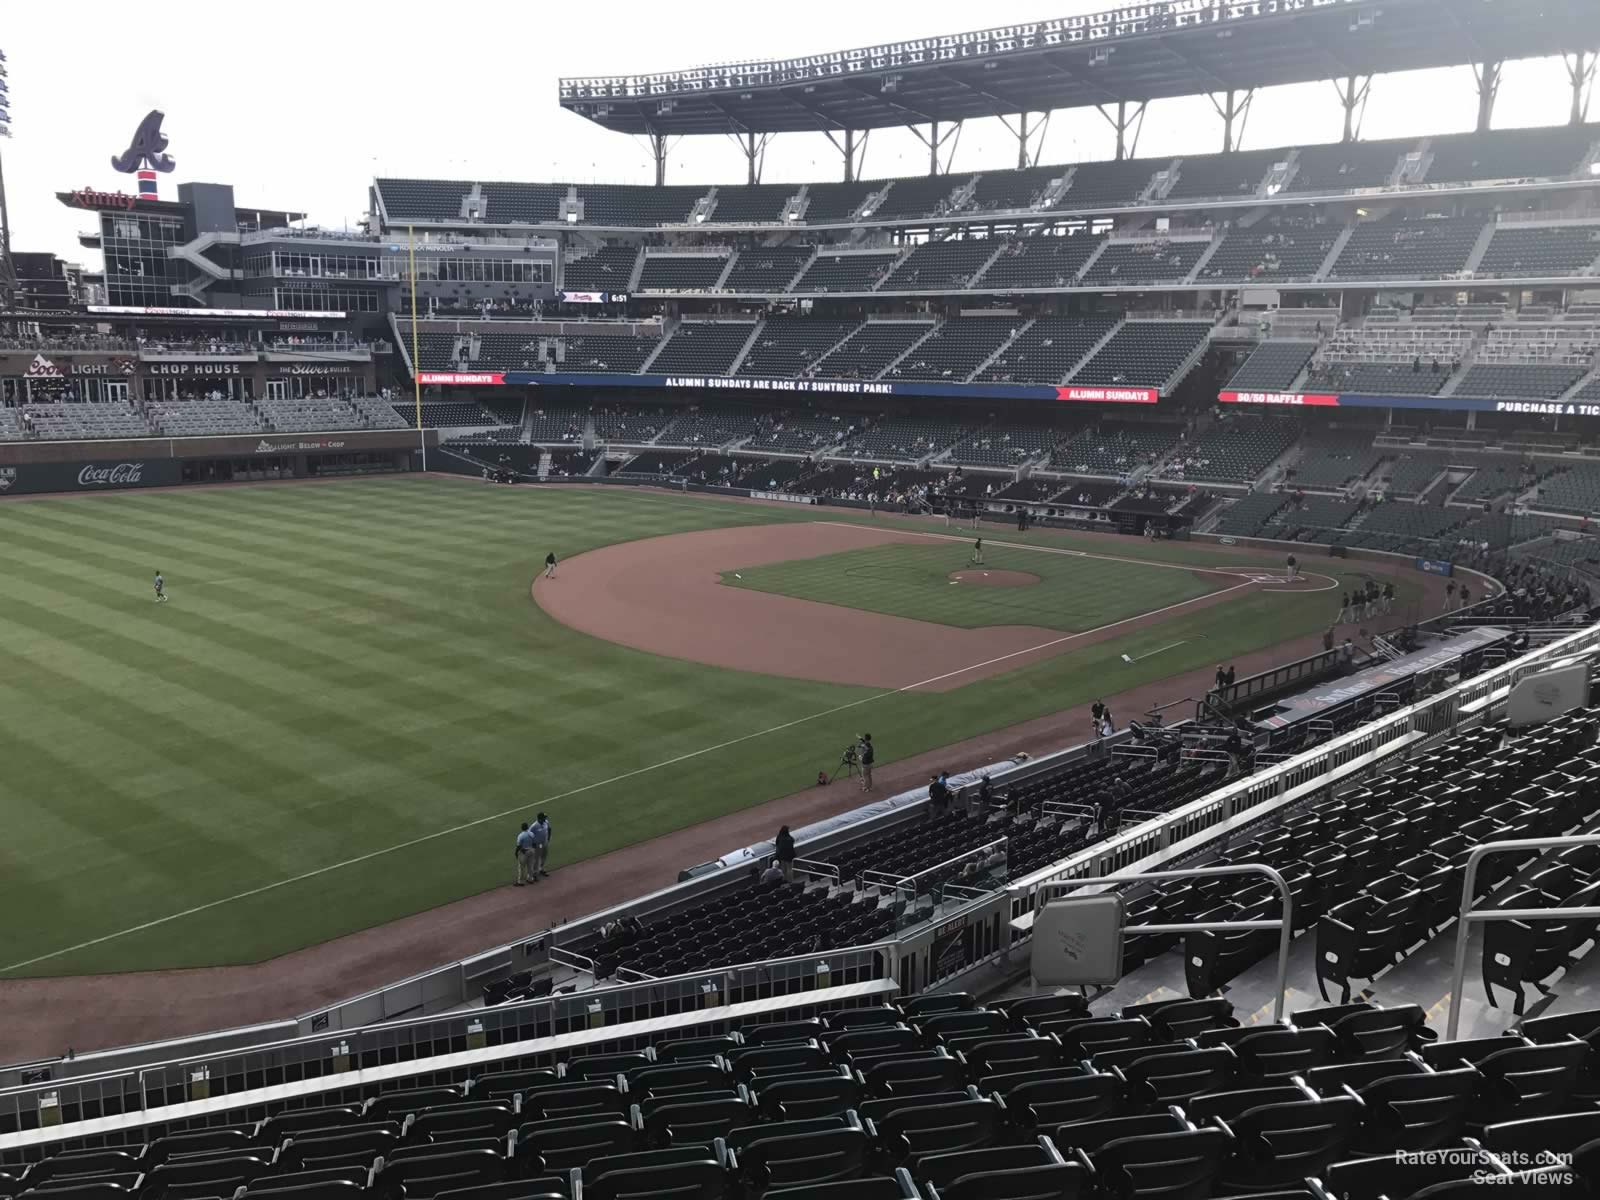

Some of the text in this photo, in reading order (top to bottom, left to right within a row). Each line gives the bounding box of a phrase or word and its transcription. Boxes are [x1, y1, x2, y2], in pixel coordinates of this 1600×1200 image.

[71, 186, 137, 208] xfinity
[611, 294, 627, 302] 6:51
[71, 364, 108, 374] LIGHT
[150, 364, 240, 374] CHOP HOUSE
[291, 364, 328, 375] Silver
[421, 375, 493, 383] ALUMNI SUNDAYS
[665, 378, 892, 393] ALUMNI SUNDAYS ARE BACK AT SUNTRUST PARK!
[1069, 390, 1149, 401] ALUMNI SUNDAYS
[1237, 393, 1304, 405] 50/50 RAFFLE
[1496, 402, 1563, 414] PURCHASE
[1566, 404, 1575, 414] A
